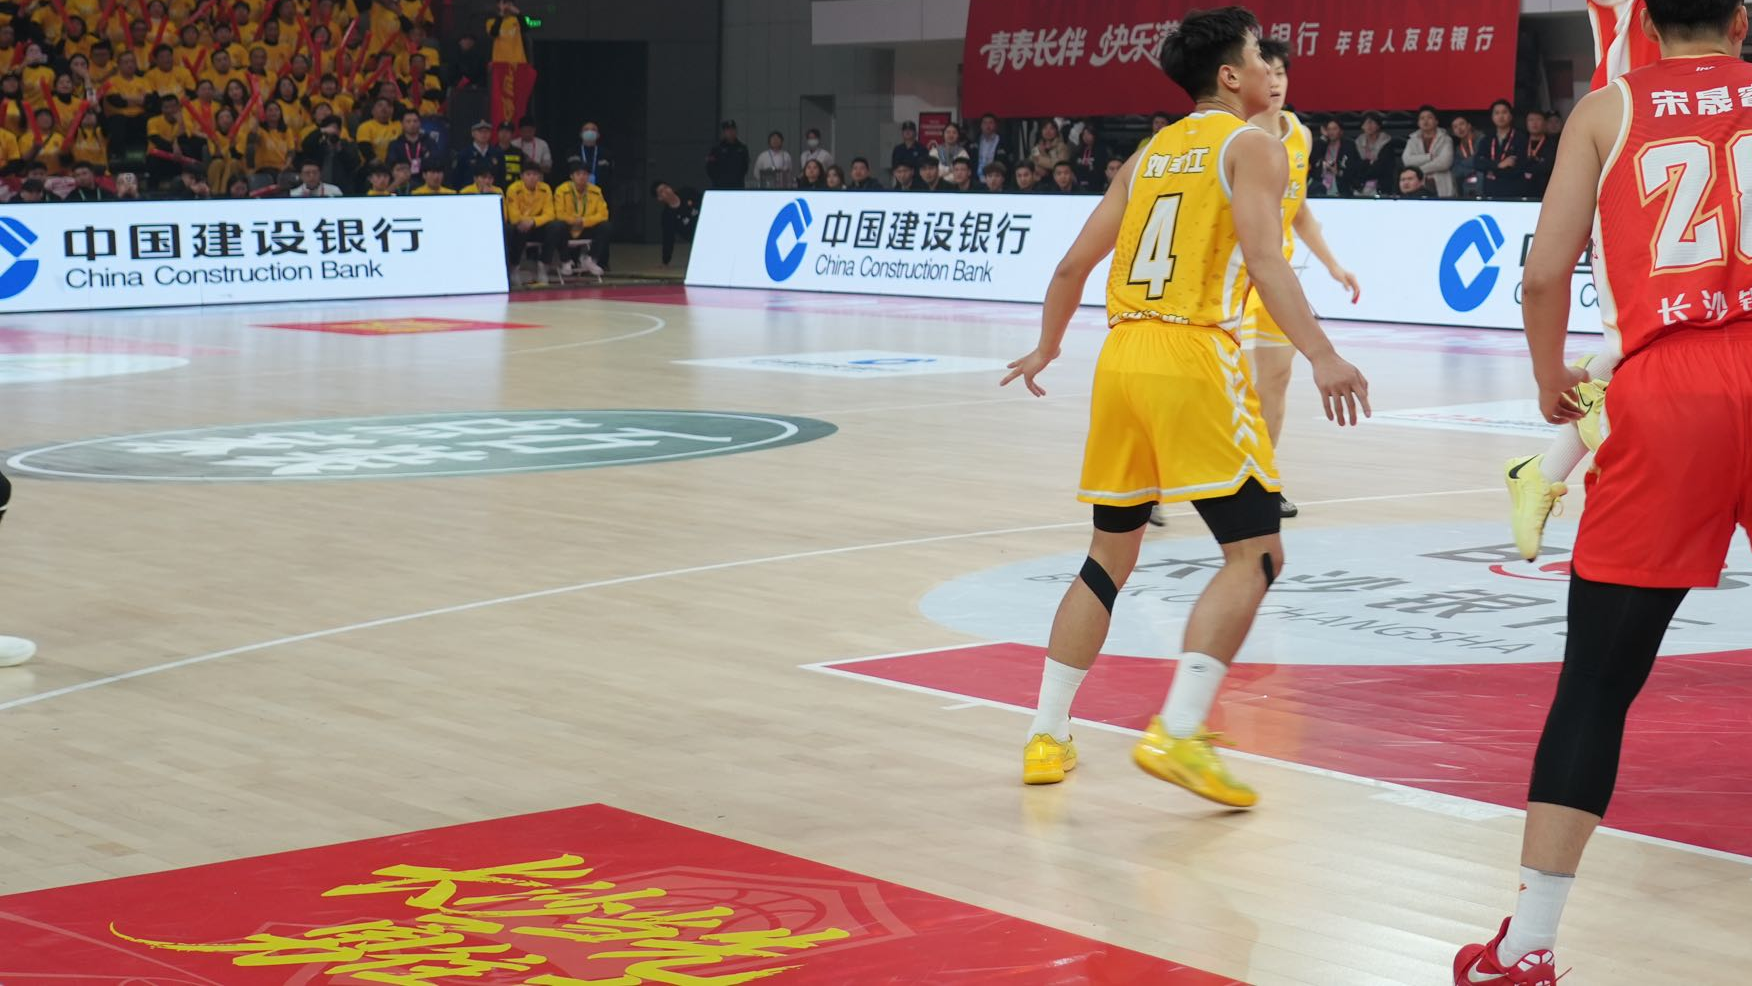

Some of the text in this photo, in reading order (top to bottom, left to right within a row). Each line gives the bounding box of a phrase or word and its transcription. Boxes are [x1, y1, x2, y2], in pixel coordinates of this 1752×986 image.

[980, 27, 1087, 75] 青春长伴
[1334, 26, 1495, 56] 年轻人友好银行
[63, 216, 424, 262] 中国建设银行
[821, 210, 1033, 255] 中国建设银行
[1126, 192, 1183, 301] 4
[64, 258, 385, 290] China Construction Bank
[815, 253, 994, 283] China Construction Bank
